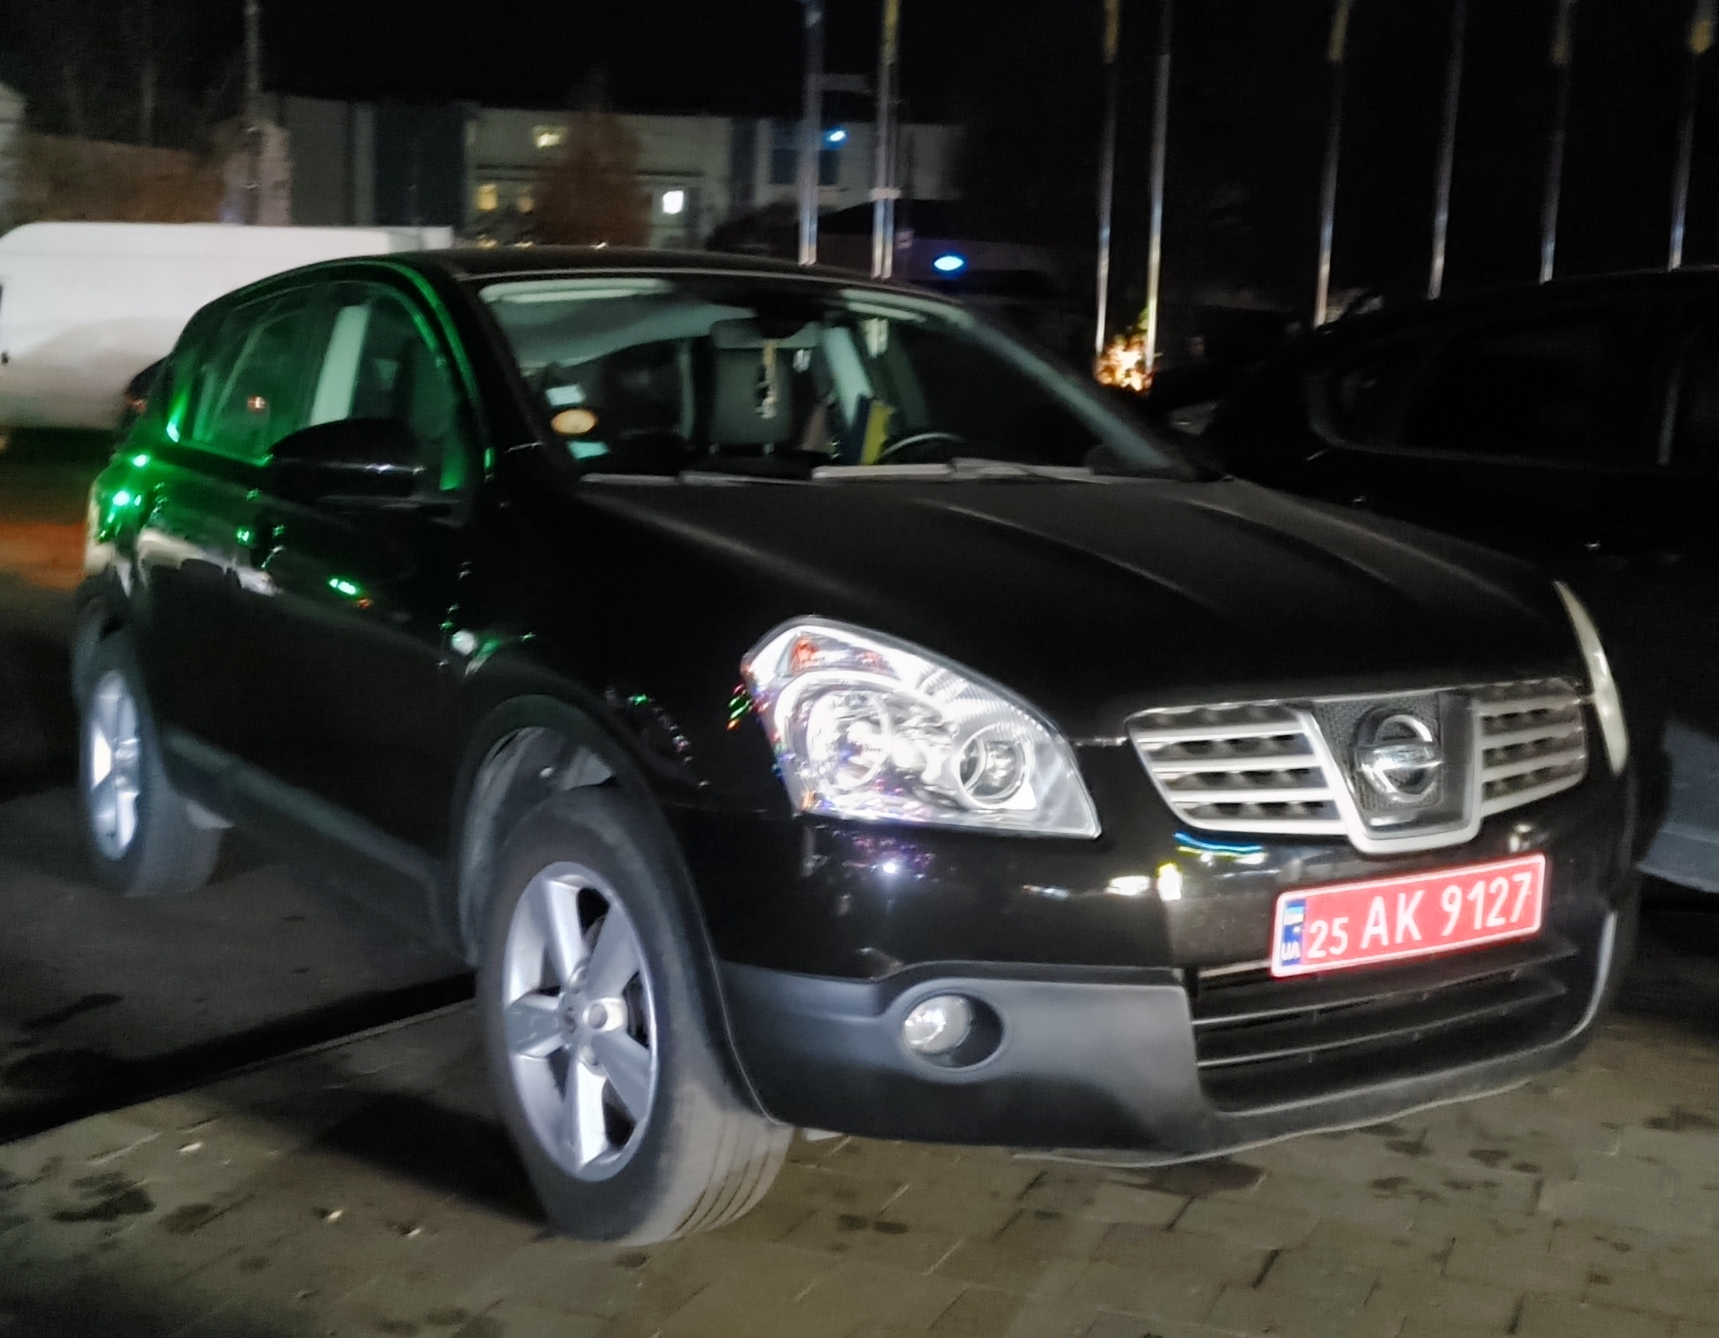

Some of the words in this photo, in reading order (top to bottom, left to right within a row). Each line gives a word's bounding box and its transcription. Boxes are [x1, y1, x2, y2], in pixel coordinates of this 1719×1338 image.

[1308, 918, 1350, 959] 25
[1361, 889, 1426, 949] AK
[1441, 871, 1532, 937] 9127
[1281, 941, 1301, 961] UA
